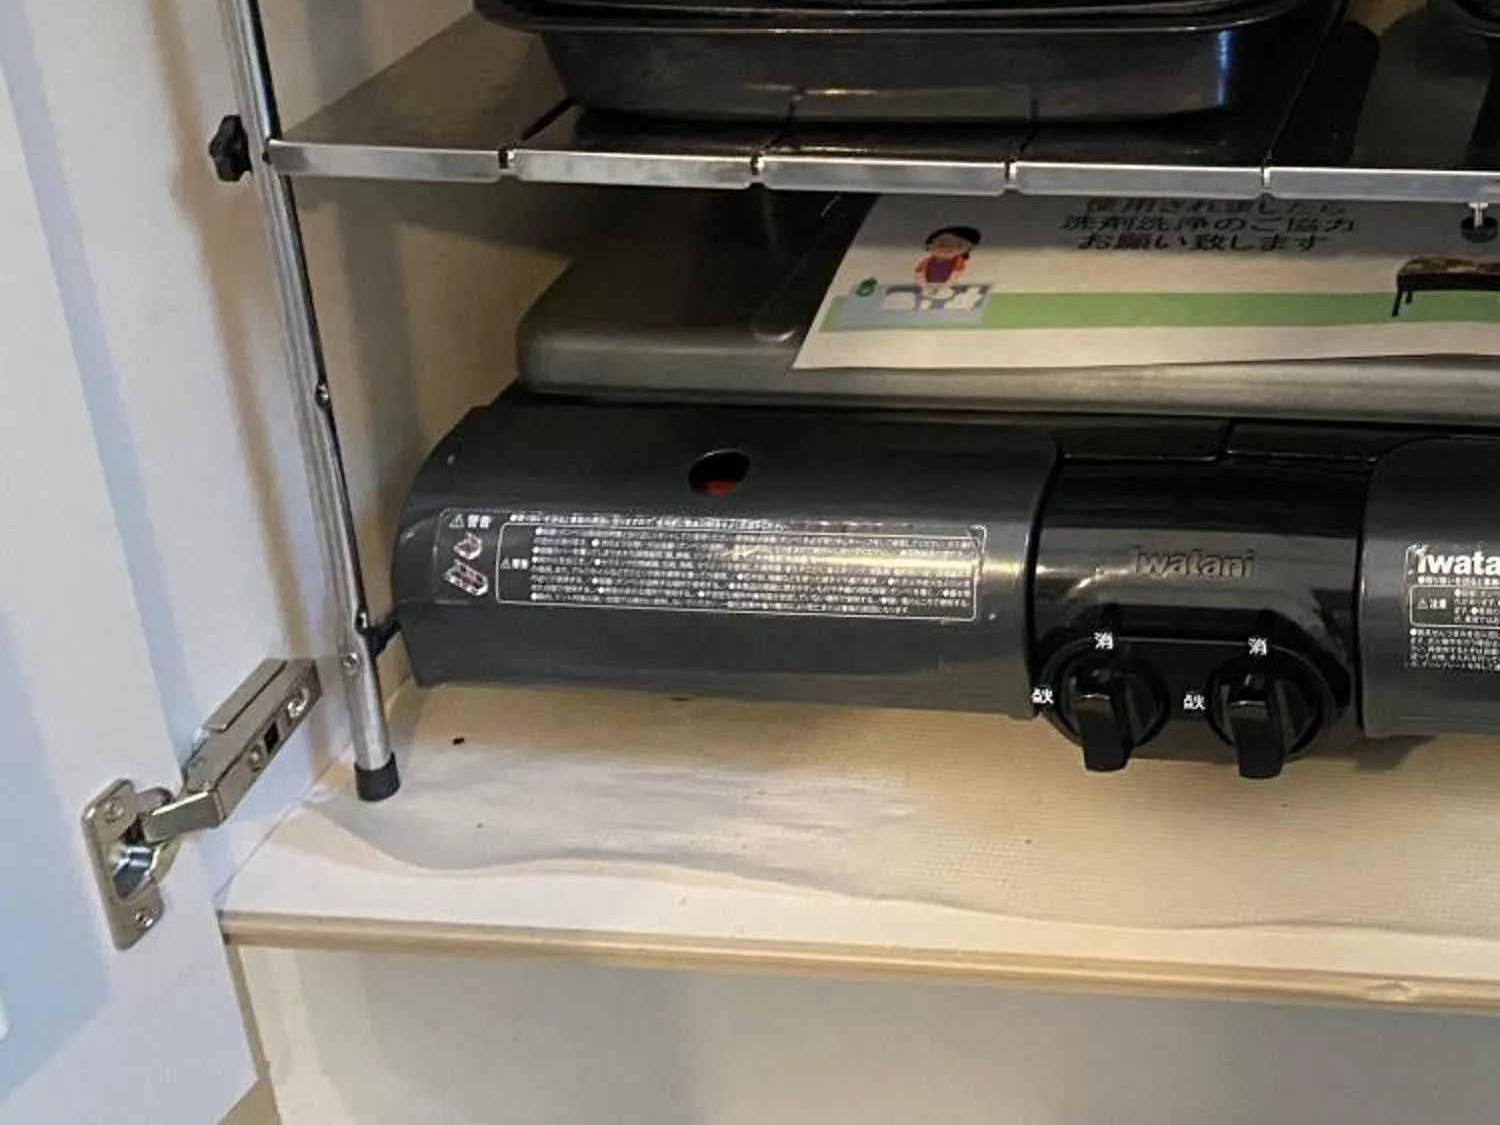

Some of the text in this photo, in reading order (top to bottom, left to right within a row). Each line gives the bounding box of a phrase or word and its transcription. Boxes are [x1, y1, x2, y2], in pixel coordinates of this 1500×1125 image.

[1060, 214, 1356, 233] 洗剤洗浄のご協力
[1077, 233, 1330, 252] お願い致します
[1093, 631, 1114, 650] 消
[1248, 637, 1268, 656] 消
[1031, 688, 1054, 705] 点火
[1183, 693, 1206, 711] 点火
